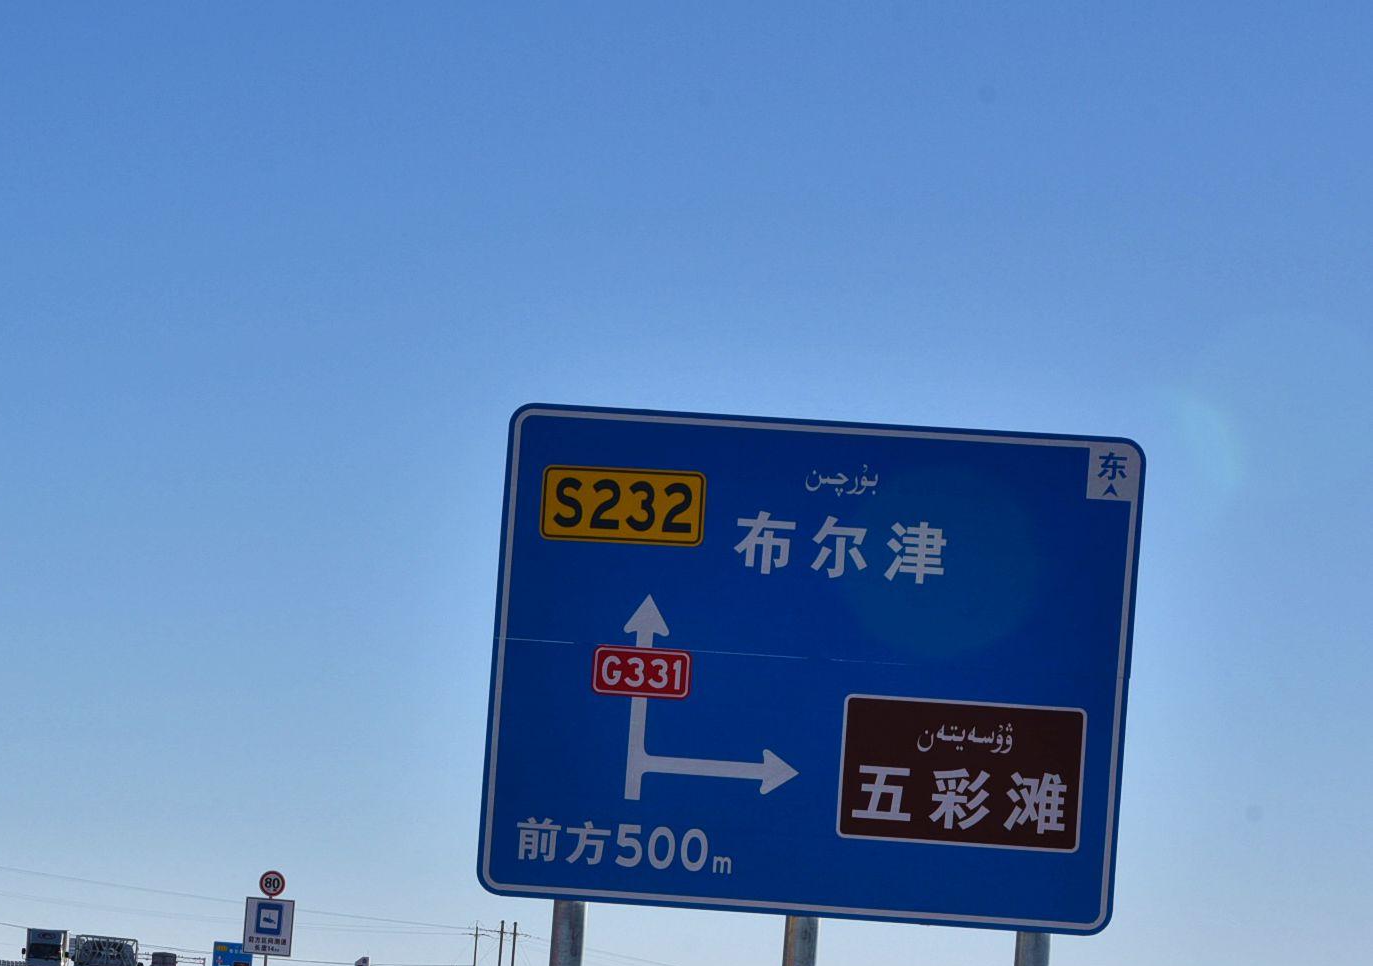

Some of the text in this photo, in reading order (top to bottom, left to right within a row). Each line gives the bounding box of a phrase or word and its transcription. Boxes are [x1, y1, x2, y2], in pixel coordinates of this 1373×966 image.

[1098, 451, 1128, 481] 东
[553, 477, 694, 534] S232
[734, 510, 947, 585] 布尔津
[601, 655, 682, 691] G331
[851, 765, 1068, 835] 五彩滩
[516, 816, 732, 875] 前方500m
[264, 877, 281, 890] 80
